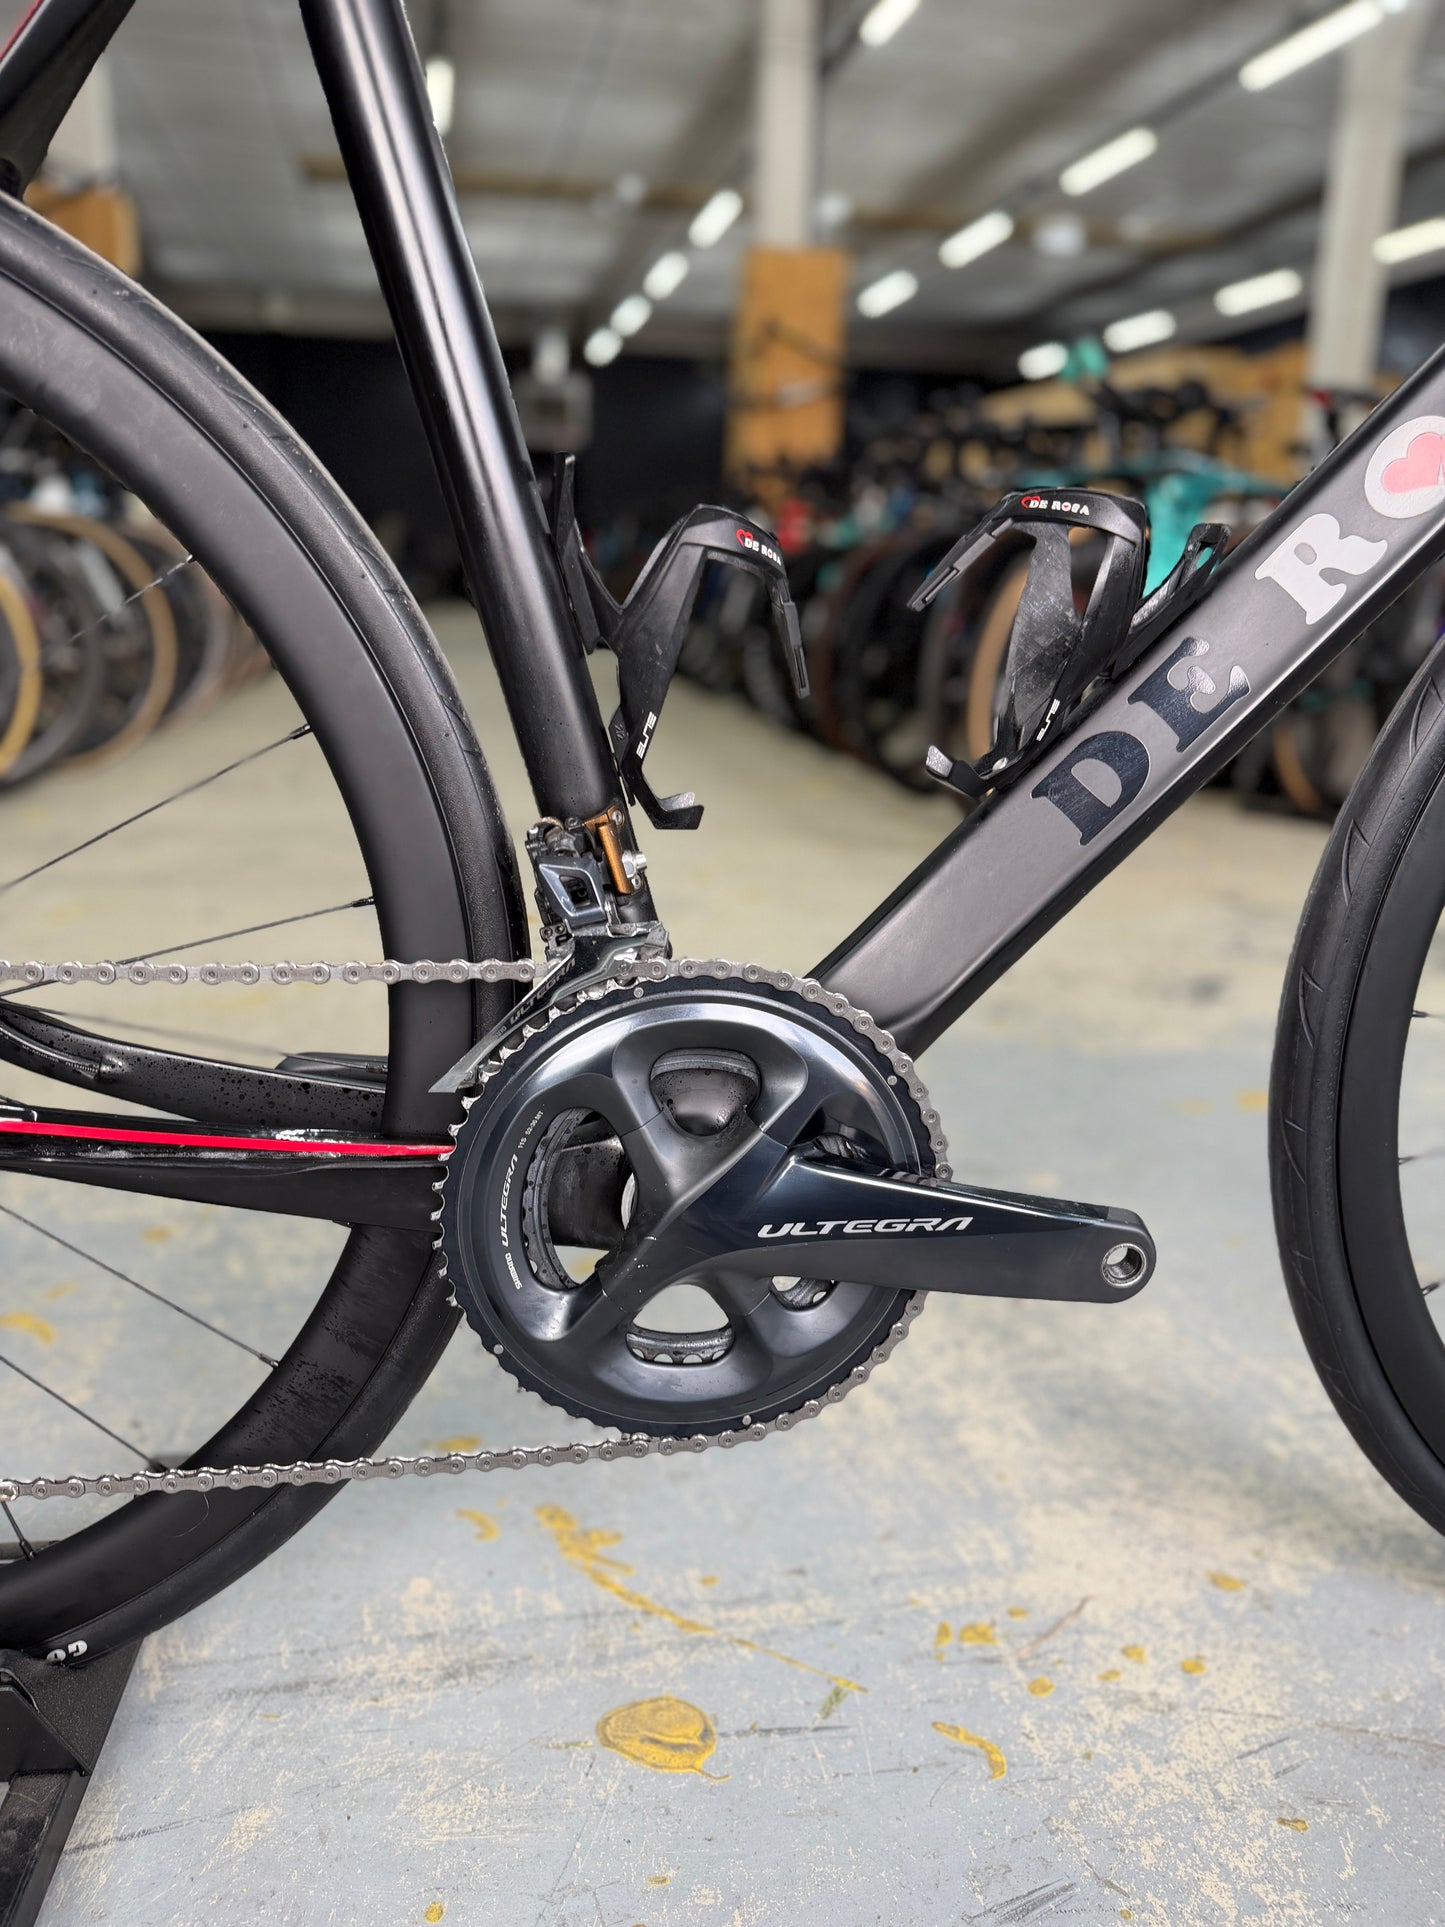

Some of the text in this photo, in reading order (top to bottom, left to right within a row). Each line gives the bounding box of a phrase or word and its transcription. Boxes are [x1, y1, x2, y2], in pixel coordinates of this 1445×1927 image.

[1028, 499, 1090, 516] DE ROSA
[744, 536, 782, 567] DE ROSA
[1030, 636, 1251, 846] DE
[510, 958, 576, 1025] ULTEGRA
[500, 1153, 518, 1248] ULTEGRA
[757, 1216, 974, 1239] ULTEGRA
[504, 1252, 523, 1290] SHIMANO
